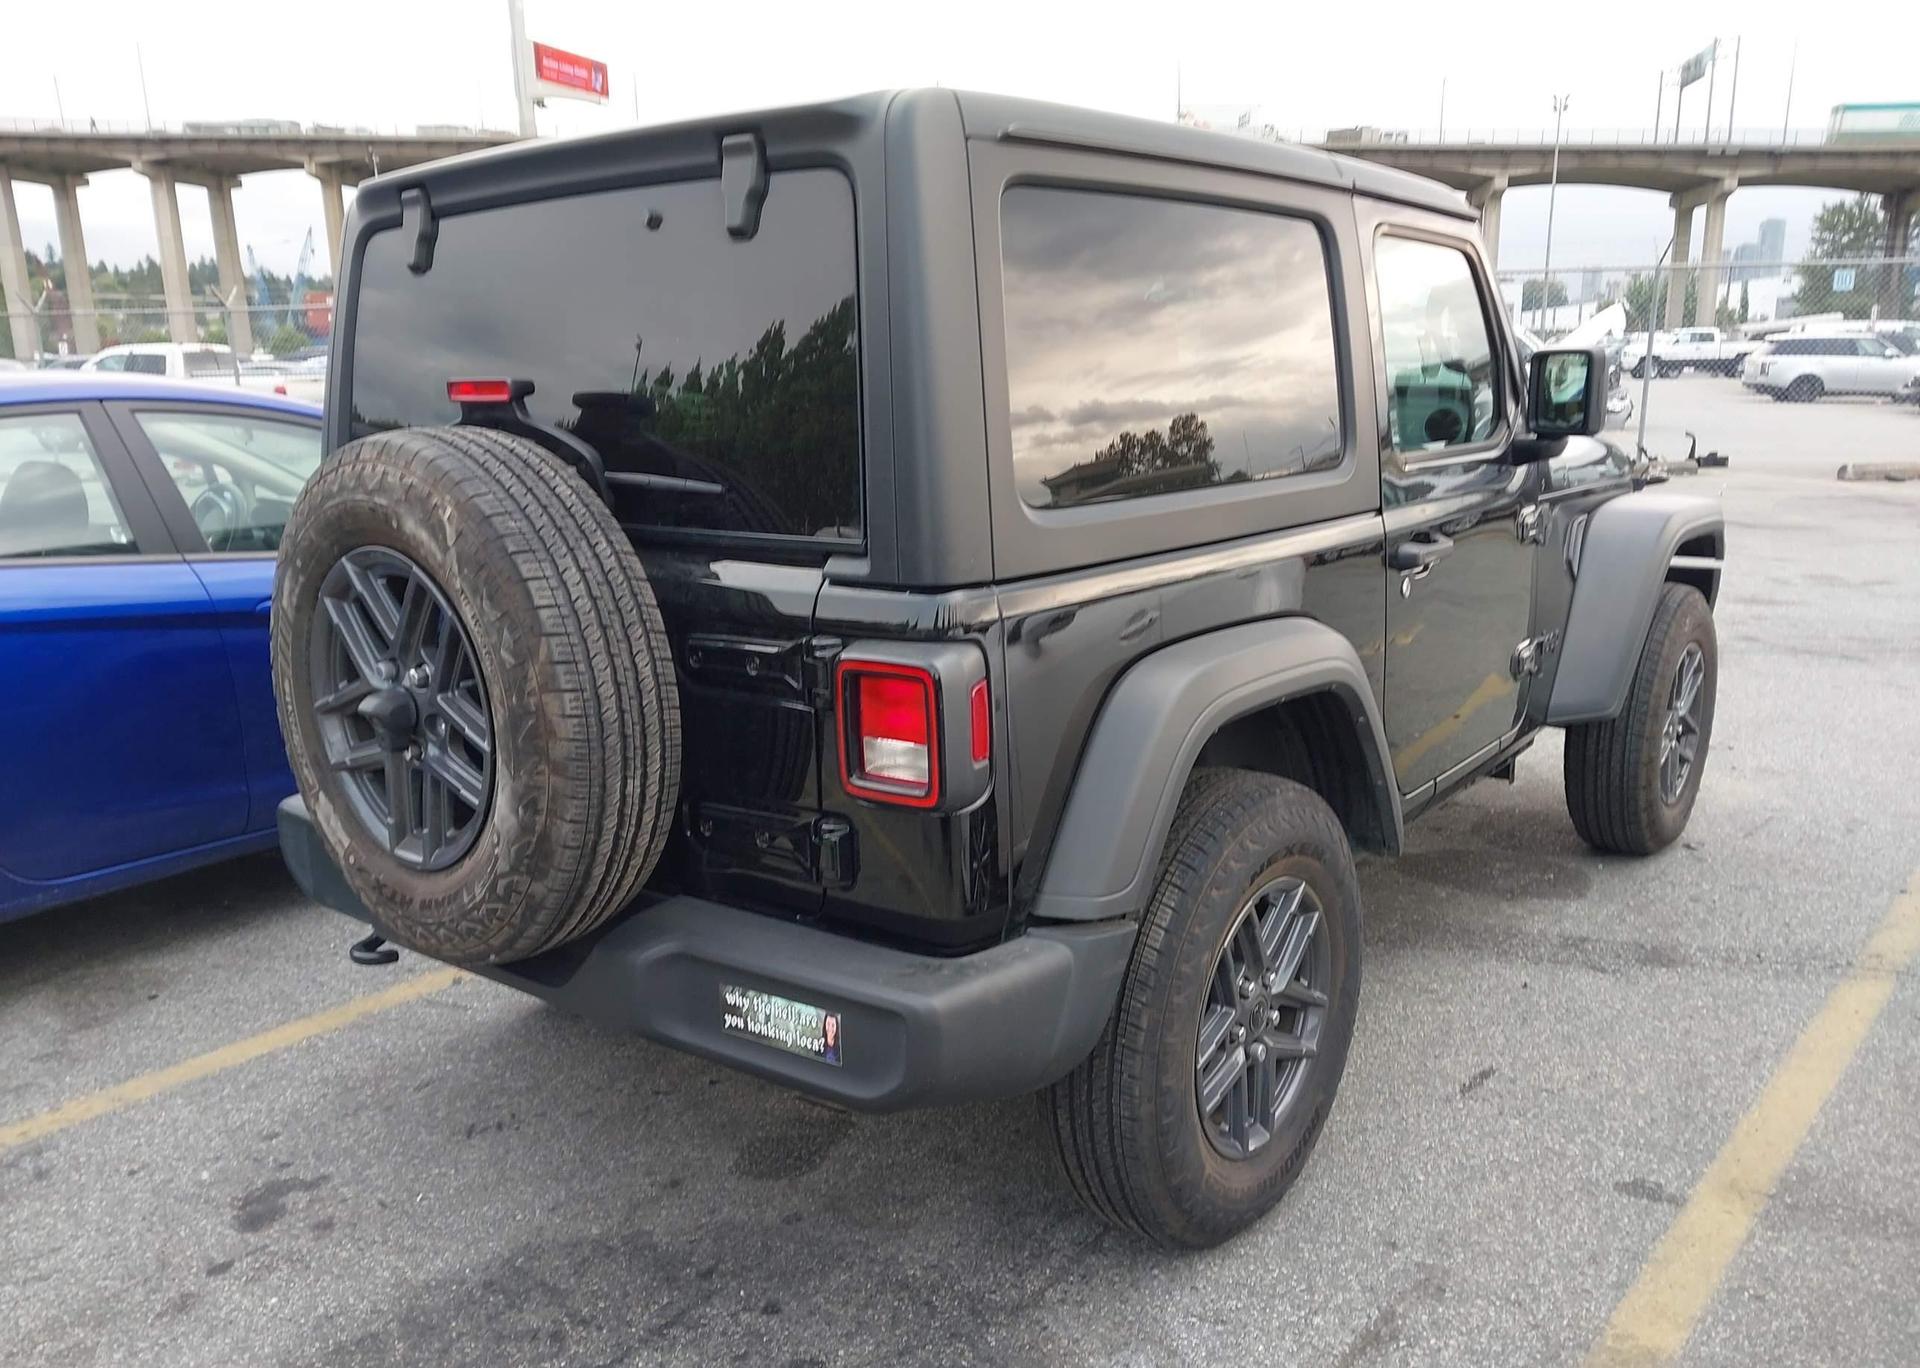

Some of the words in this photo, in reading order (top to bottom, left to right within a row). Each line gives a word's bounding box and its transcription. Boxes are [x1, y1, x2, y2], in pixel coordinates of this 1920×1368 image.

[725, 991, 750, 1013] why
[752, 996, 771, 1016] the
[775, 1001, 795, 1022] hell
[800, 1012, 818, 1029] are
[724, 1013, 745, 1030] you
[747, 1015, 793, 1048] honking
[796, 1030, 825, 1053] loca?
